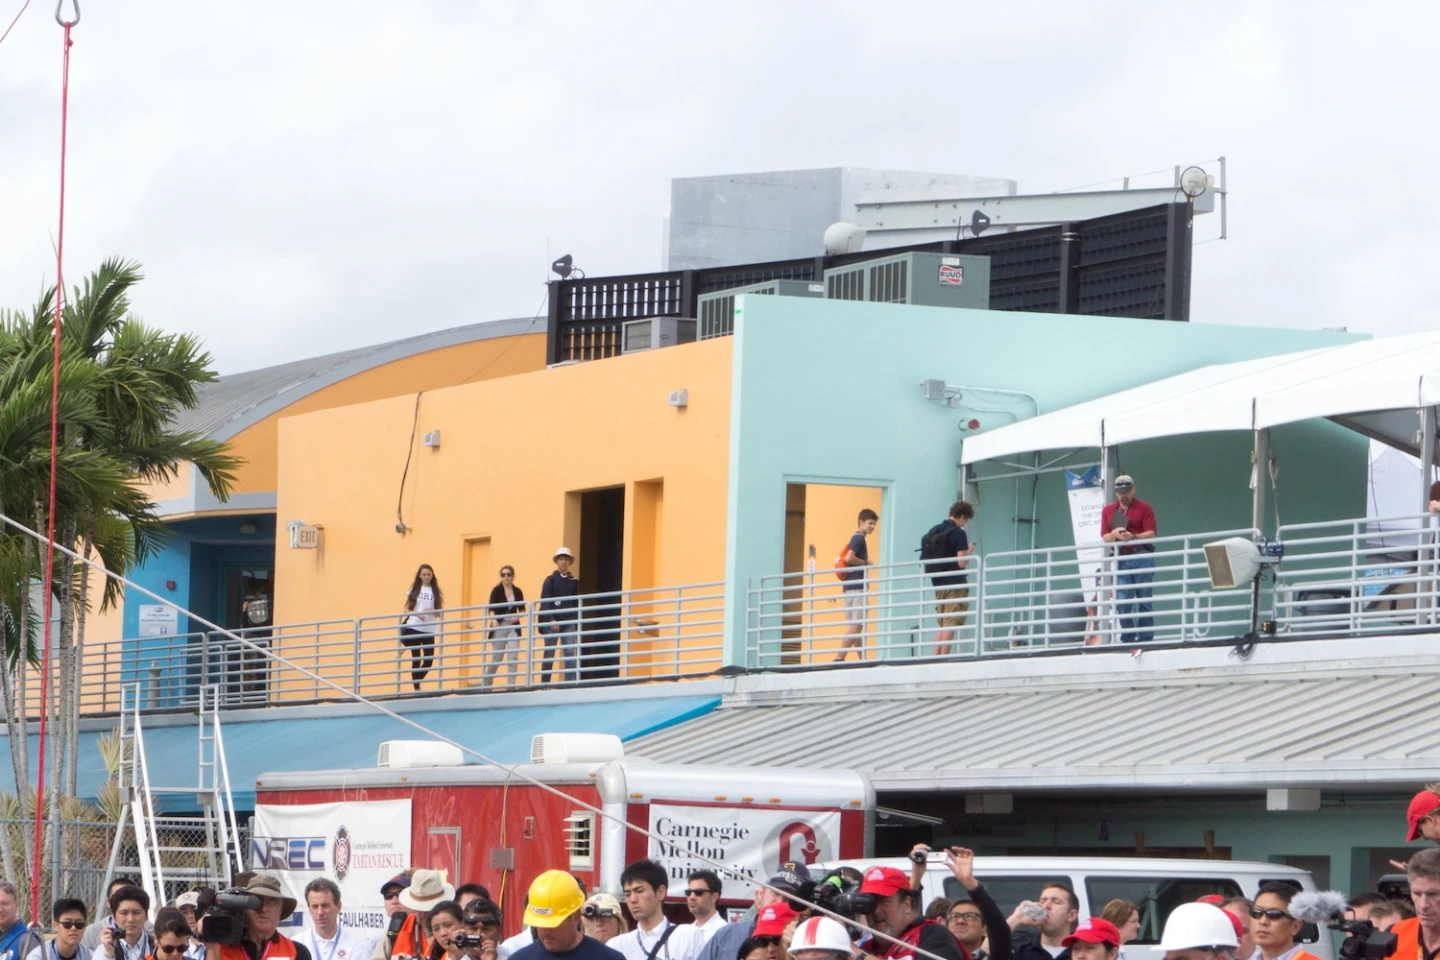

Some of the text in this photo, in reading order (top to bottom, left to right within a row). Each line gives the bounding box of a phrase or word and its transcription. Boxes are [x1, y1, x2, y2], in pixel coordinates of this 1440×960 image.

[300, 530, 316, 543] EXIT
[655, 816, 750, 845] Carnegie
[252, 838, 327, 869] NREC
[656, 839, 726, 860] Mellon
[374, 853, 405, 868] RESCUE
[338, 911, 385, 929] FAULHABER
